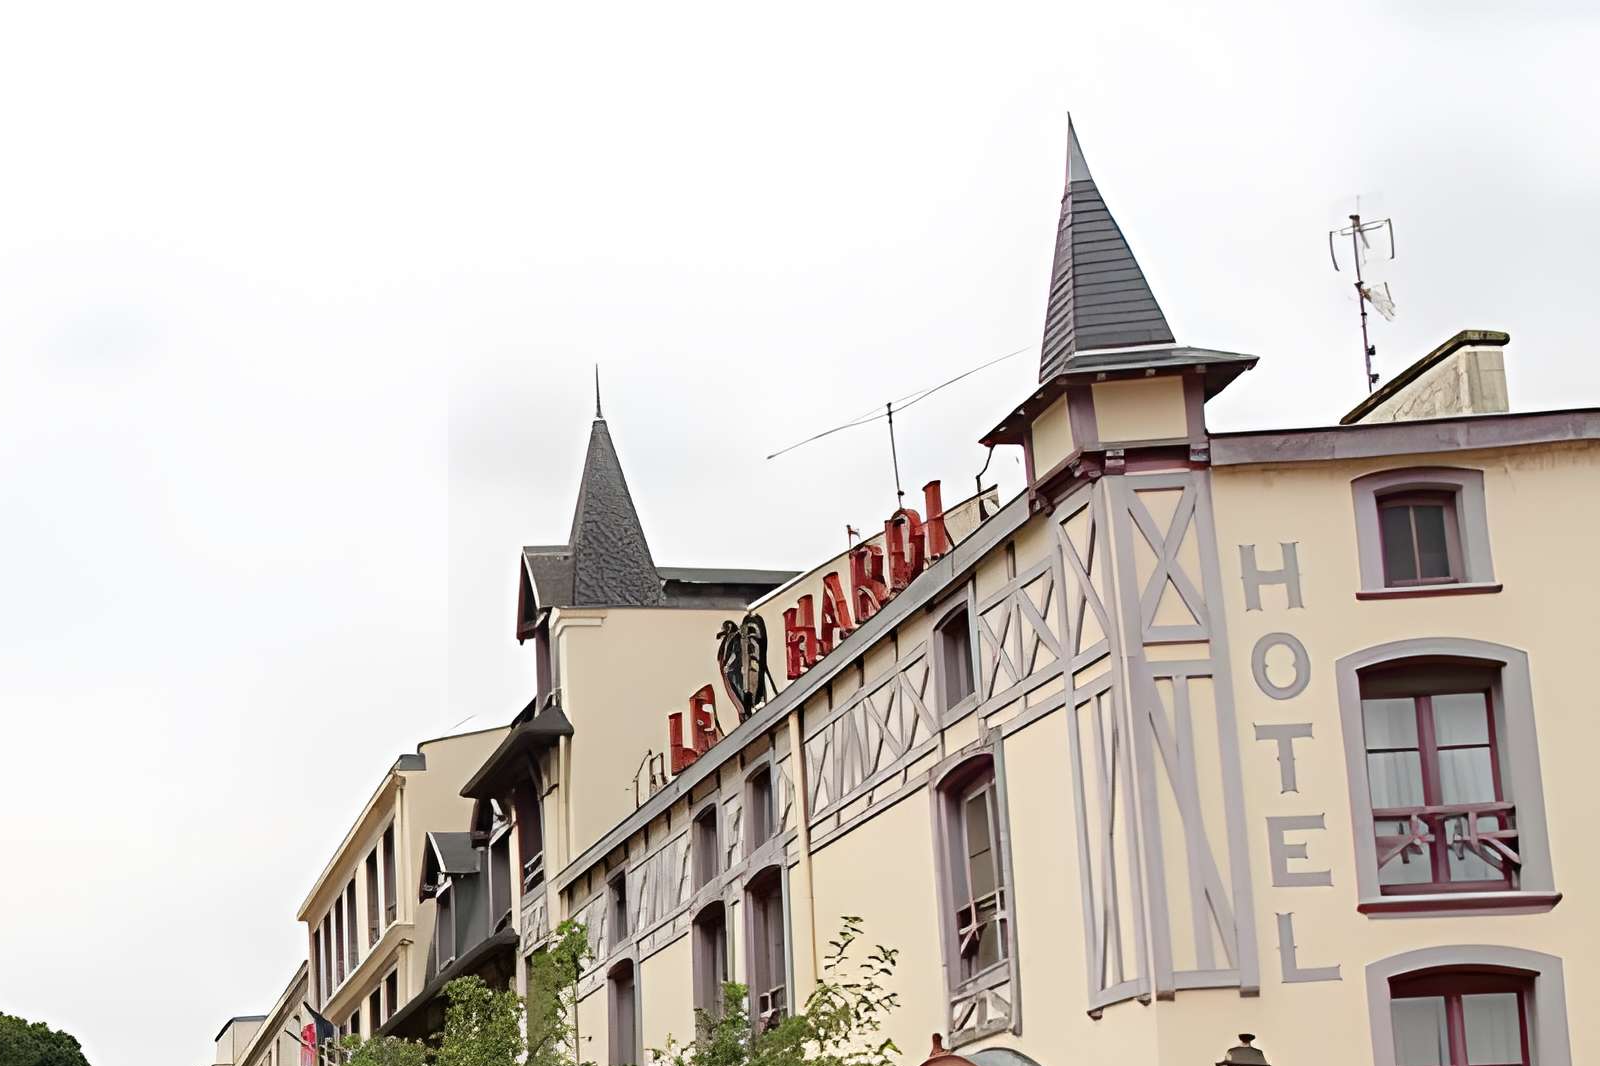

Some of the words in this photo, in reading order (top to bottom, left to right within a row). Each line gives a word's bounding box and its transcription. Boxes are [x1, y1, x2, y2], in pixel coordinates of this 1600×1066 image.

[668, 684, 717, 776] LE
[783, 480, 946, 680] HARDI
[1238, 541, 1344, 984] HOTEL
